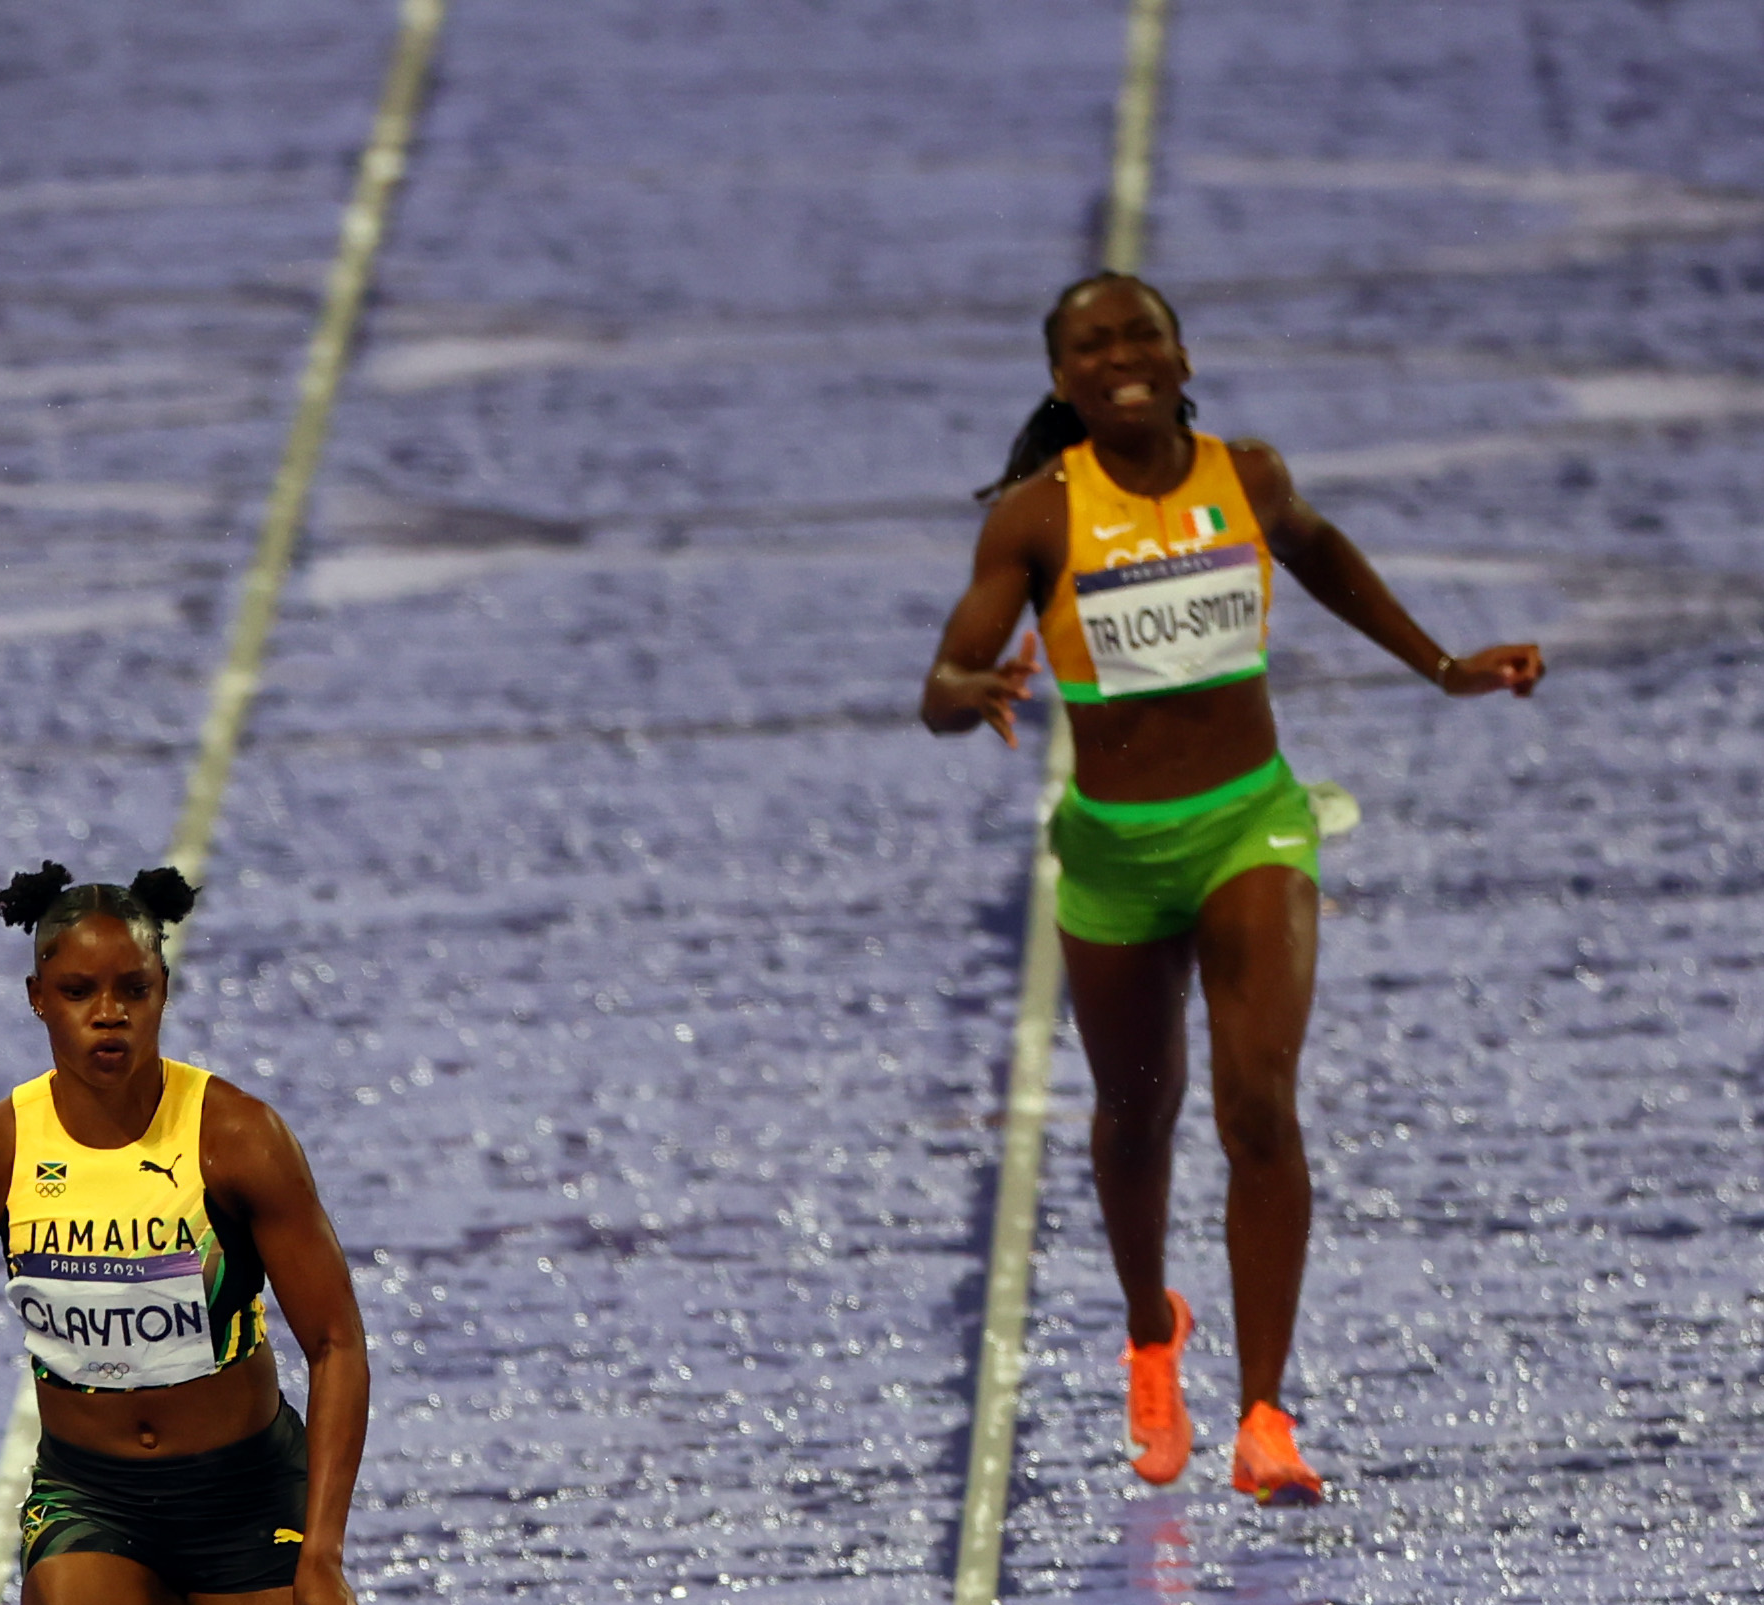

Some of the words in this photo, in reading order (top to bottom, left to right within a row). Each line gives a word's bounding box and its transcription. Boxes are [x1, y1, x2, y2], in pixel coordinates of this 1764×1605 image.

[1124, 590, 1256, 649] LOU-SMITH
[24, 1217, 198, 1254] JAMAICA
[50, 1260, 97, 1275] PARIS
[103, 1262, 145, 1277] 2024
[20, 1297, 202, 1346] CLAYTON
